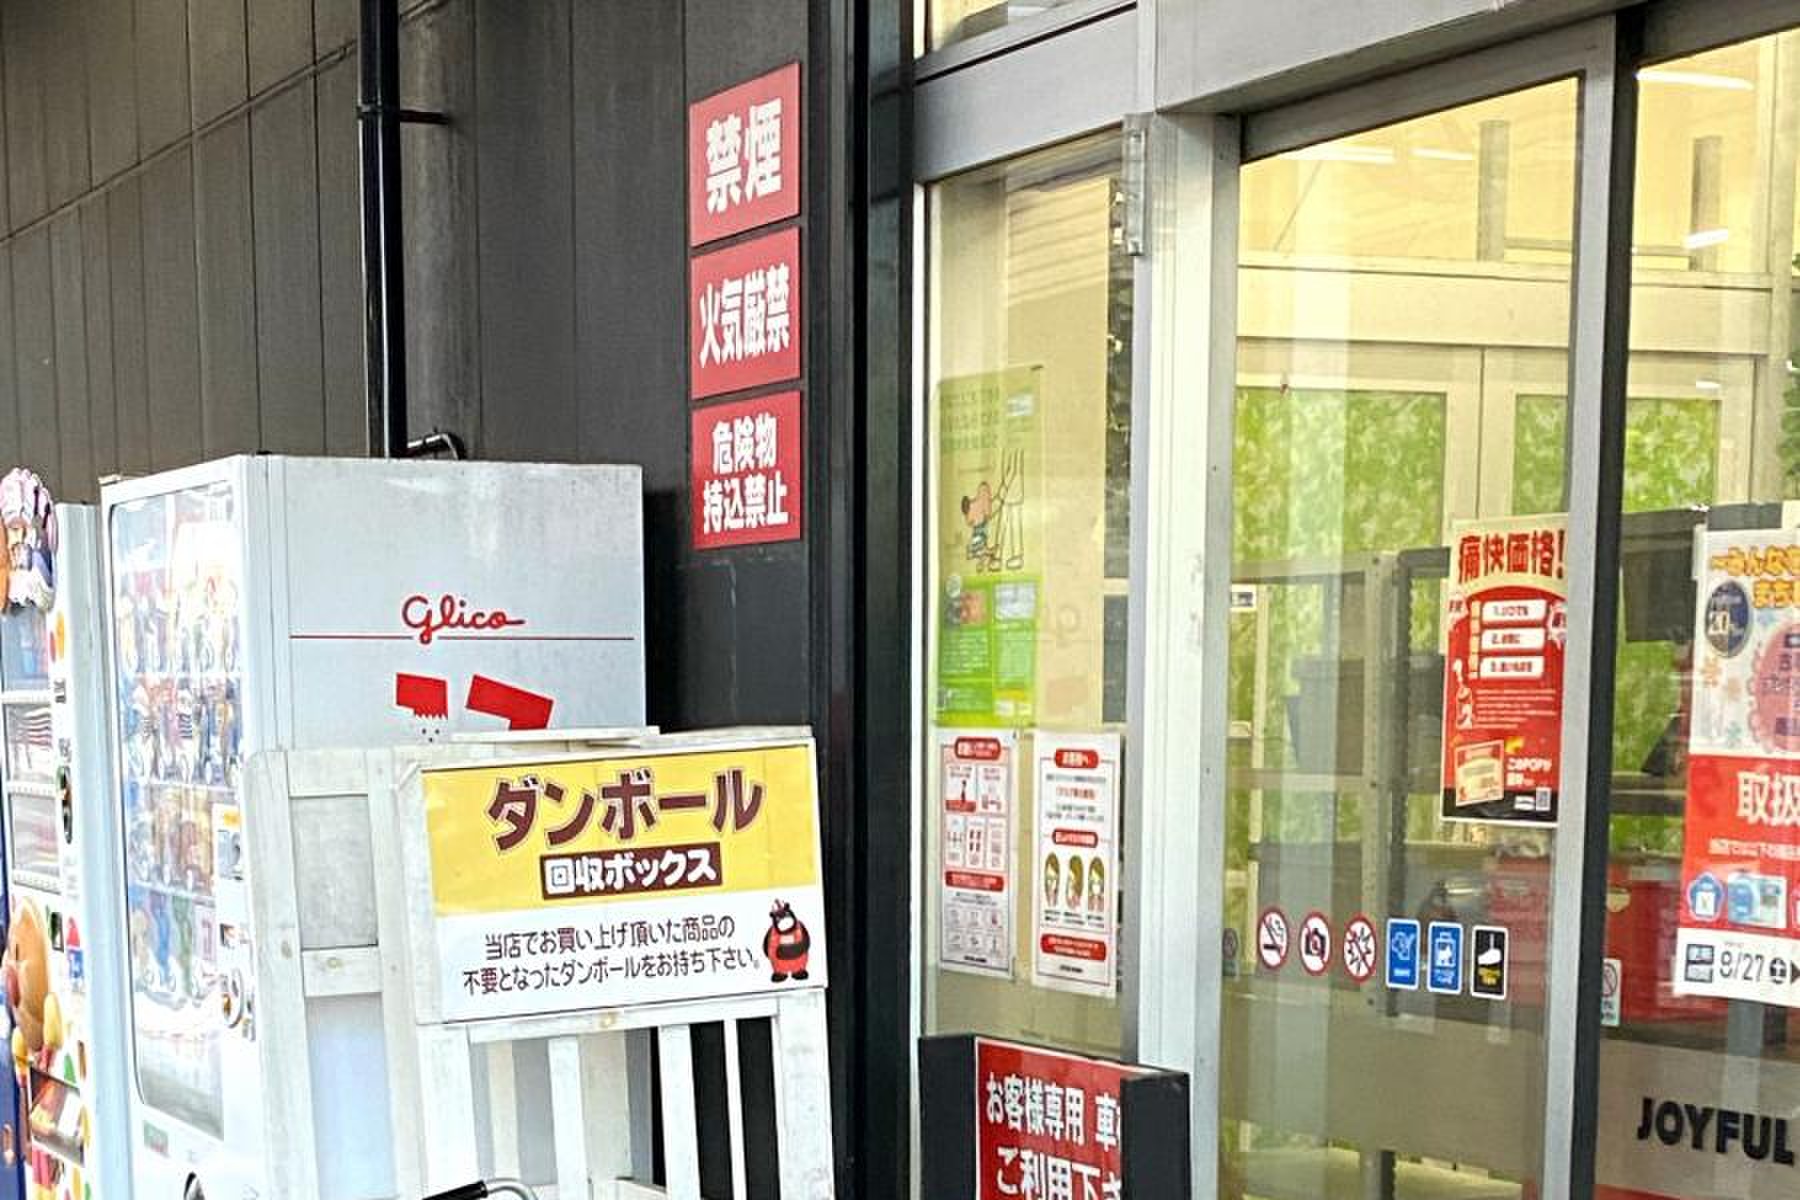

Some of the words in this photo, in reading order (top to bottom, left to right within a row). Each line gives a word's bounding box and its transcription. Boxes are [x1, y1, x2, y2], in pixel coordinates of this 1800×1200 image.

[706, 97, 782, 213] 禁煙
[699, 262, 790, 368] 火気厳禁
[711, 410, 778, 474] 危険物
[702, 471, 789, 535] 持込禁止
[402, 593, 526, 645] Glico
[486, 767, 764, 852] ダンボール
[544, 848, 717, 896] 回収ボックス
[485, 914, 736, 961] 当店でお買い上げ頂いた商品の
[985, 1072, 1085, 1146] お客様専用
[1637, 1096, 1795, 1166] JOYFUL
